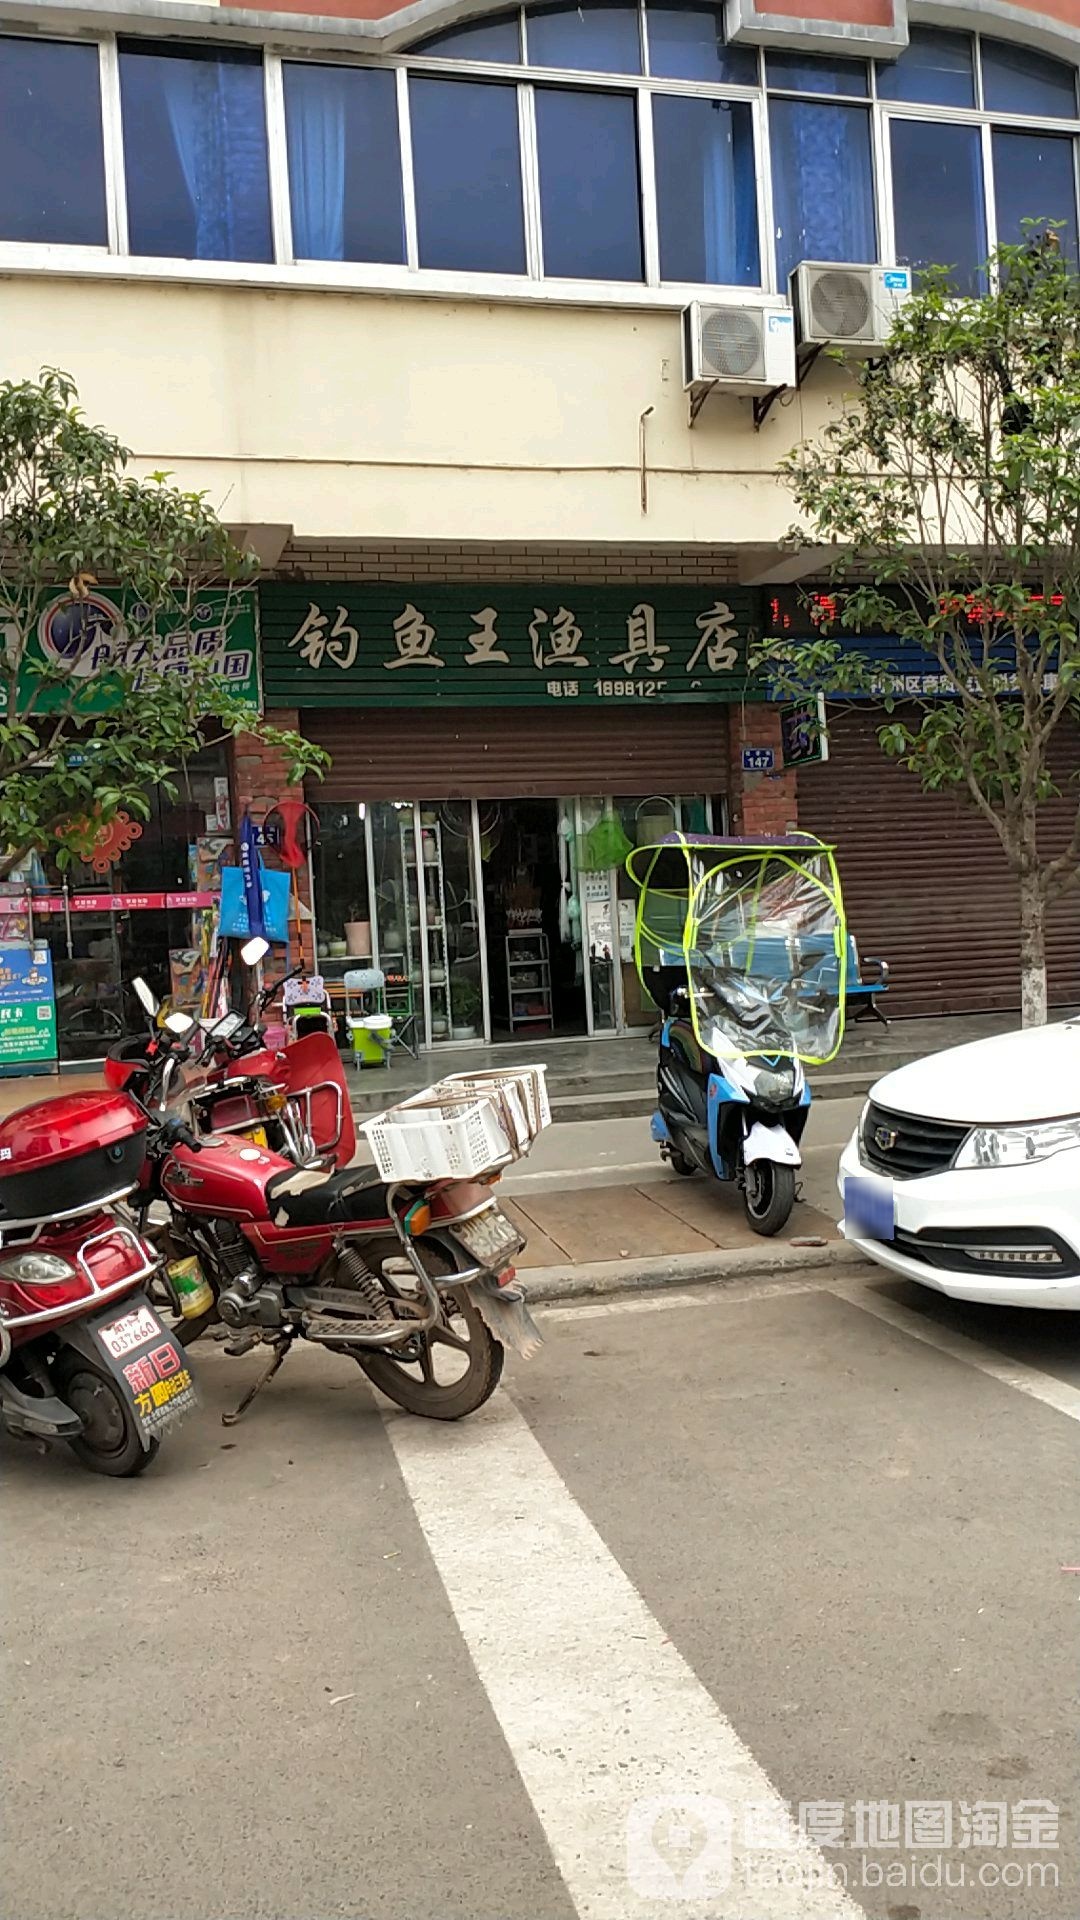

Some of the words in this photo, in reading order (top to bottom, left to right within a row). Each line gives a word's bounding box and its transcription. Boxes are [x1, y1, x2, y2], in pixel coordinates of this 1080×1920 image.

[288, 601, 740, 674] 钓鱼王渔具店
[547, 680, 579, 697] 电话
[747, 756, 769, 768] 147
[111, 1321, 155, 1353] 037660
[122, 1342, 181, 1395] 新日
